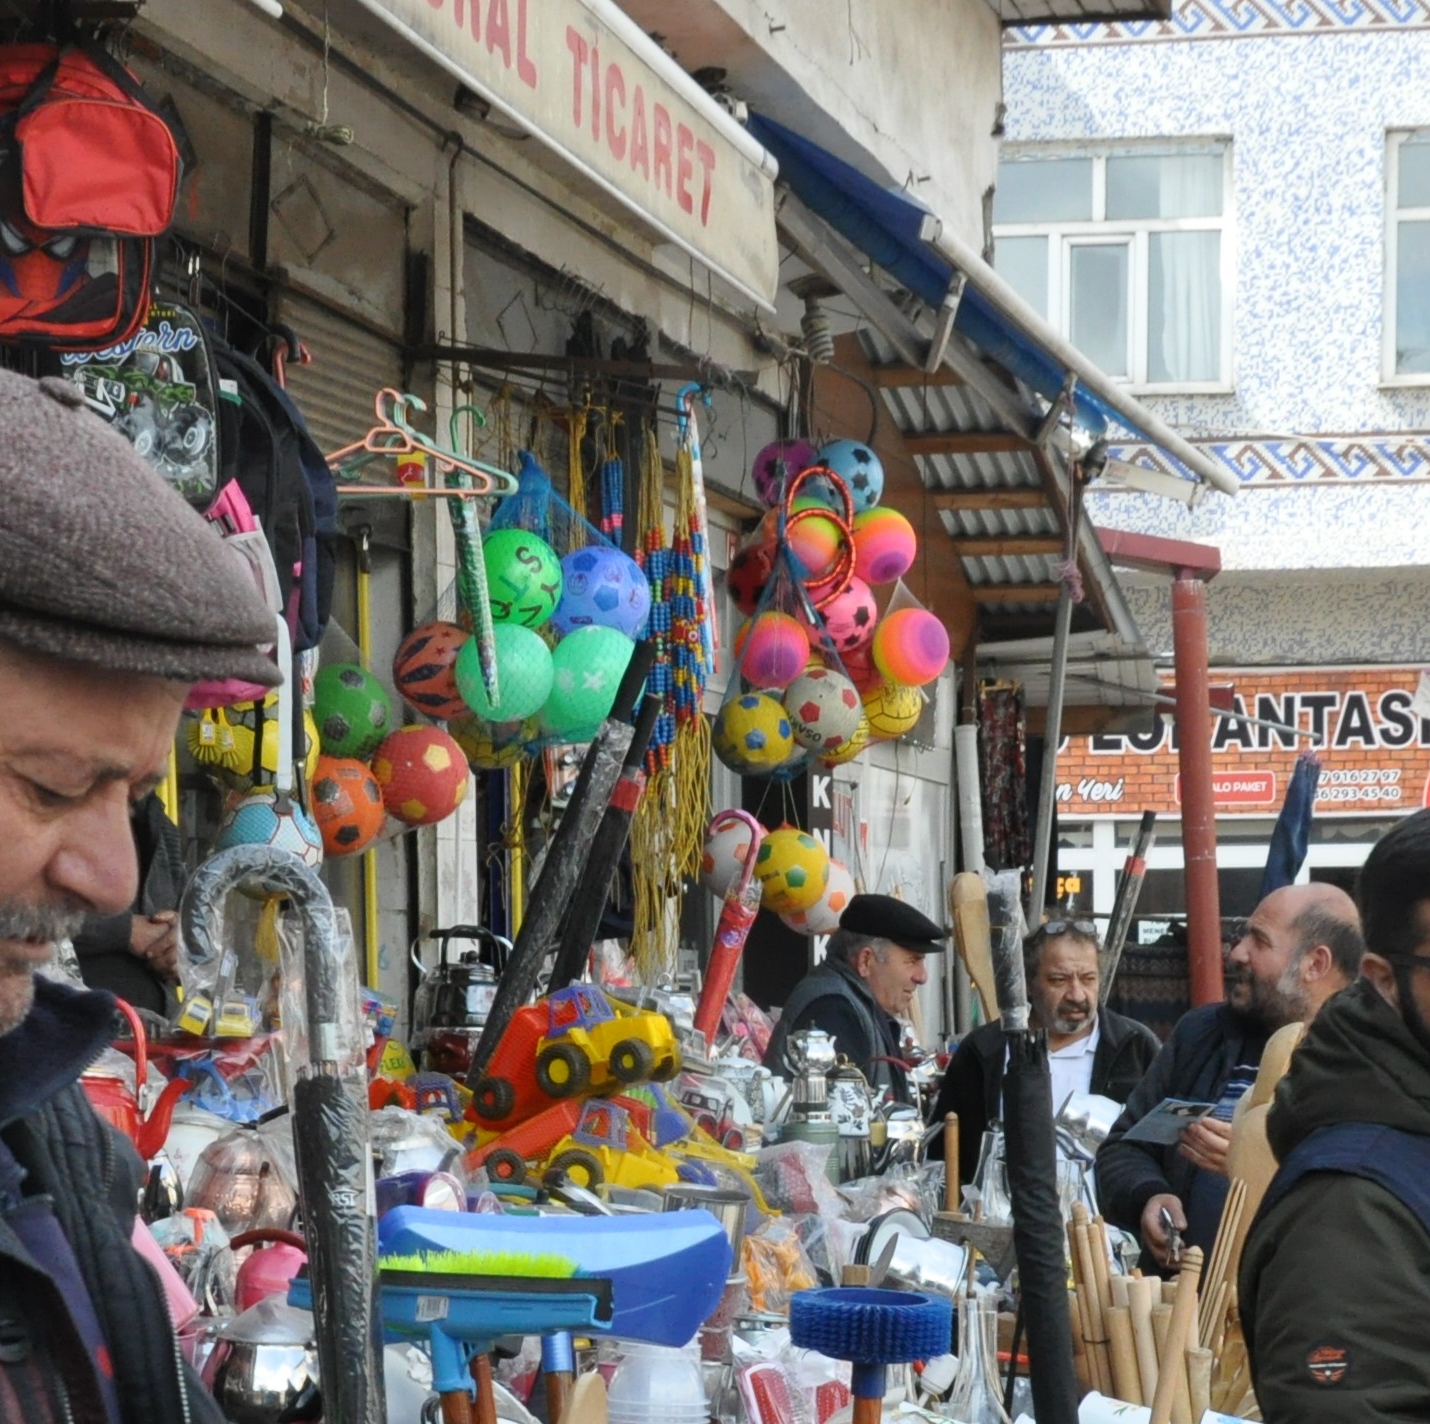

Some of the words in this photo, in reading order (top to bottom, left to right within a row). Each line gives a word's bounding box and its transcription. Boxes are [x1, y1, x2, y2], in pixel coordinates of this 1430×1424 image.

[566, 25, 715, 227] TİCARET
[1332, 771, 1358, 783] 916
[1361, 771, 1378, 782] 27
[1382, 771, 1400, 782] 97
[1232, 781, 1267, 793] PAKET
[1331, 788, 1358, 799] 293
[1361, 788, 1378, 799] 45
[1382, 788, 1400, 798] 40
